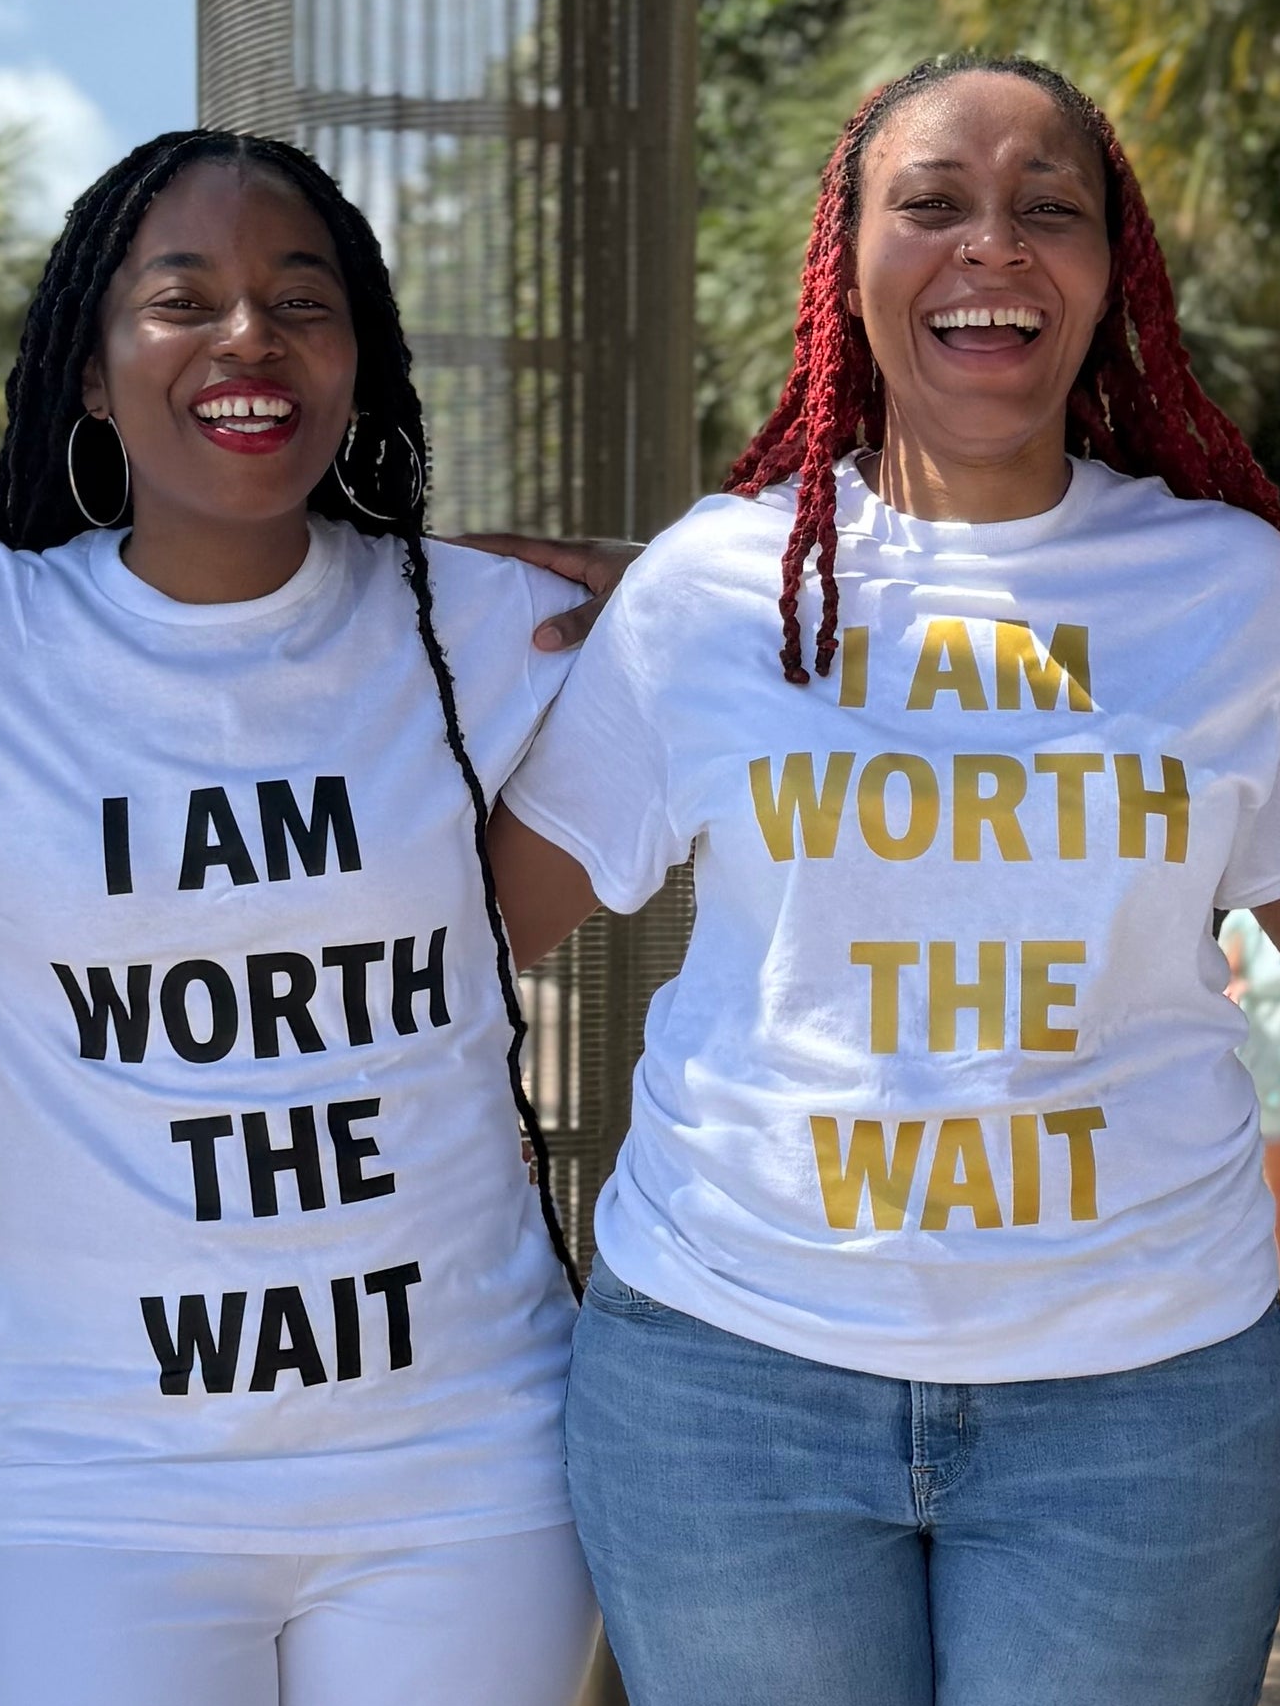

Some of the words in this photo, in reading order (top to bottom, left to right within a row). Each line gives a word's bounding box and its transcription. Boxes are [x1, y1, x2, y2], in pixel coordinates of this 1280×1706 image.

[838, 626, 869, 708] I
[905, 619, 1094, 712] AM
[102, 796, 133, 895] I
[177, 776, 362, 890] AM
[748, 751, 1190, 864] WORTH
[50, 926, 452, 1063] WORTH
[850, 940, 1087, 1054] THE
[170, 1097, 395, 1221] THE
[809, 1106, 1107, 1231] WAIT
[140, 1261, 422, 1395] WAIT
